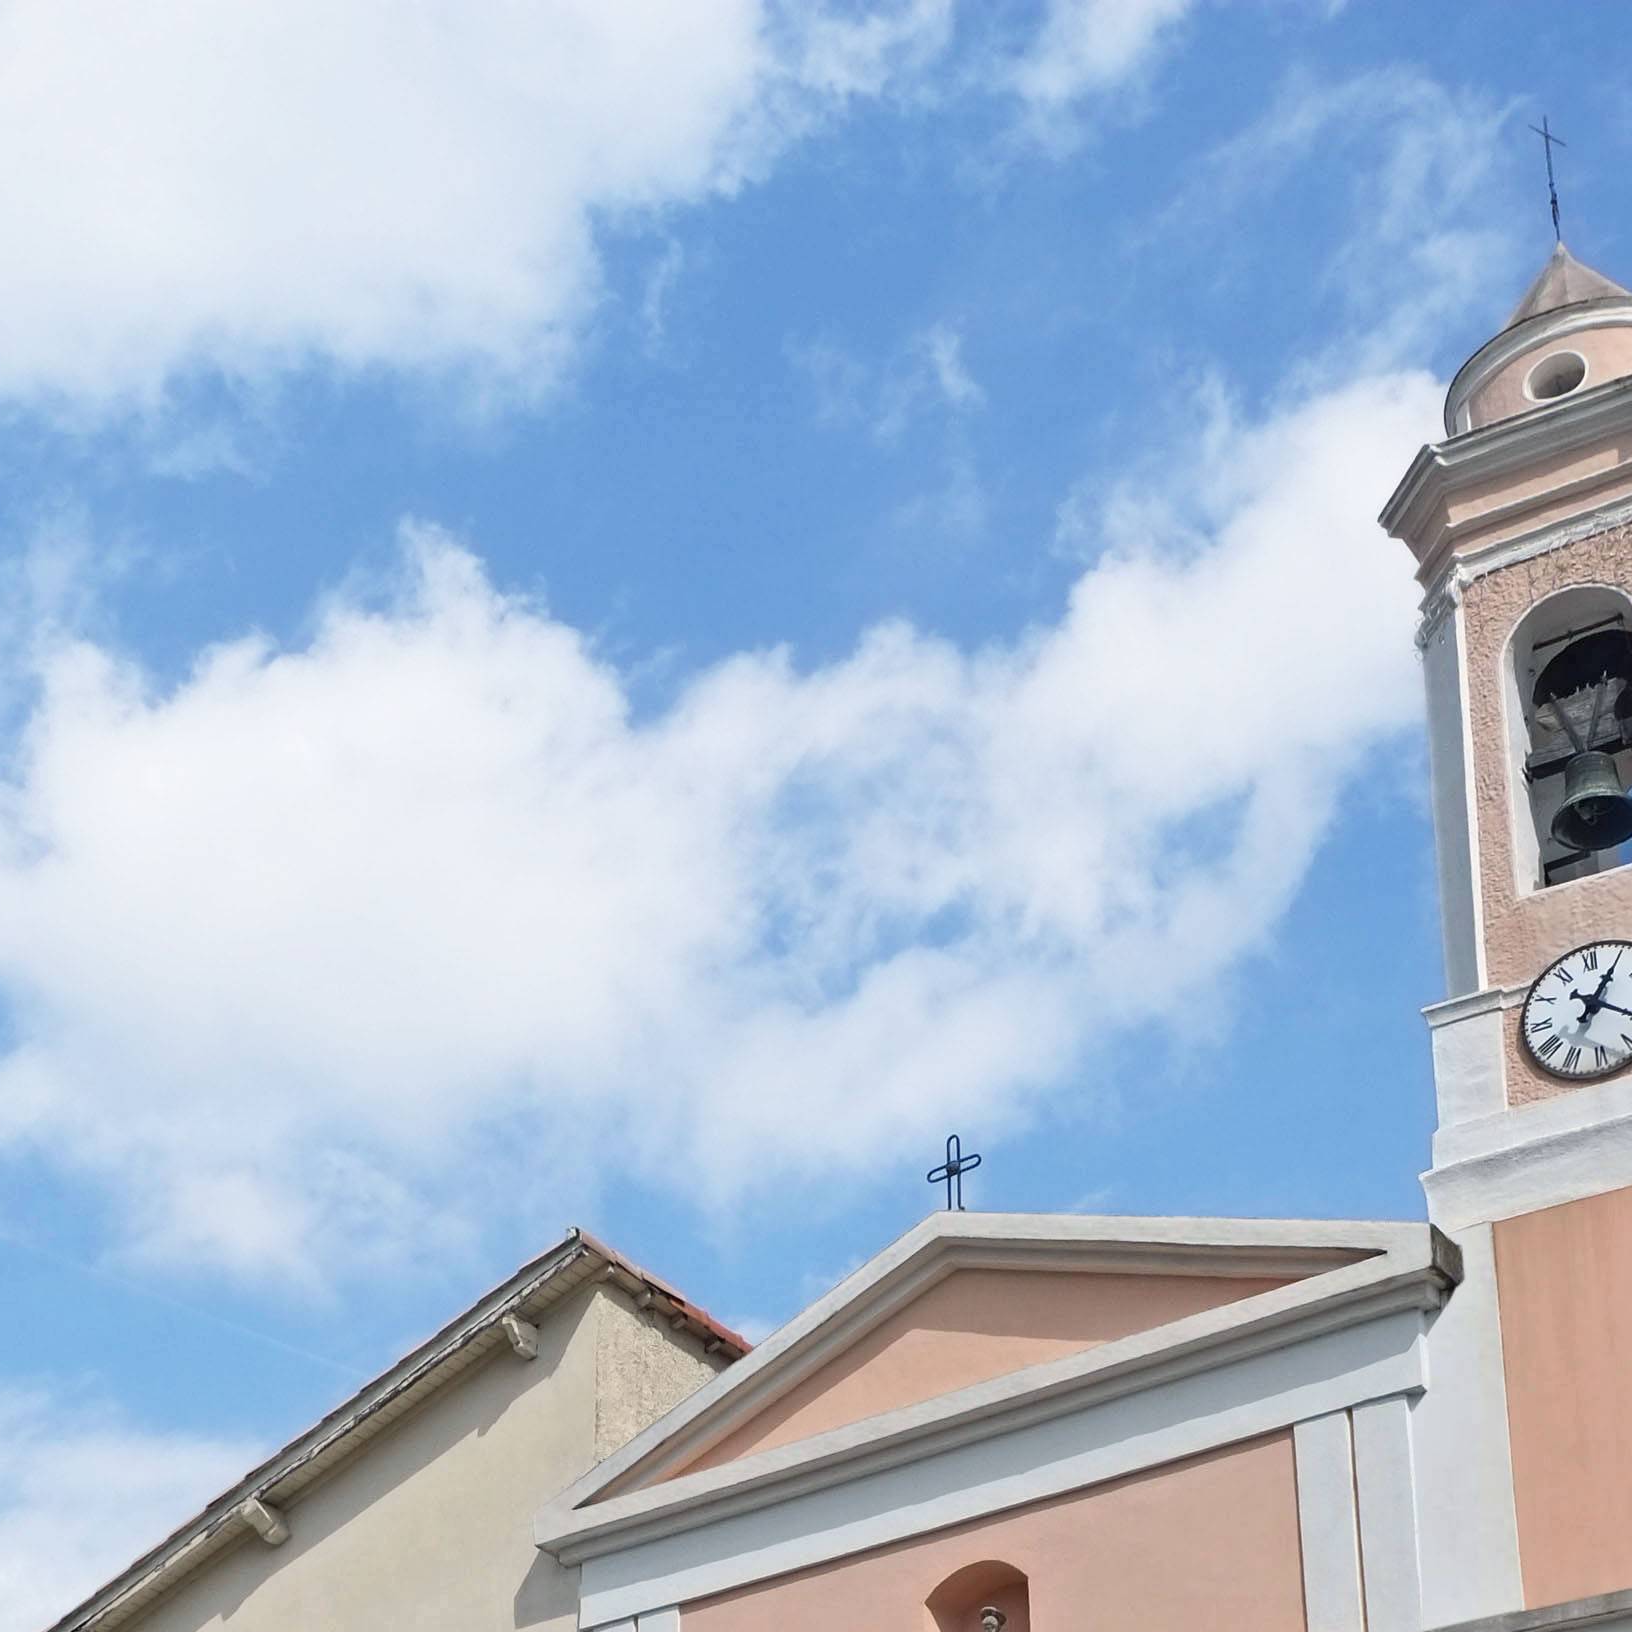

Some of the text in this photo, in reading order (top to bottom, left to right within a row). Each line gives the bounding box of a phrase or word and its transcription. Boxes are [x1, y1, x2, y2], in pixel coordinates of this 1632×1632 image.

[1581, 950, 1599, 973] XII
[1553, 967, 1574, 986] XI
[1534, 994, 1557, 1005] X
[1530, 1017, 1553, 1033] IX
[1562, 1046, 1581, 1070] VII
[1594, 1045, 1608, 1067] VI
